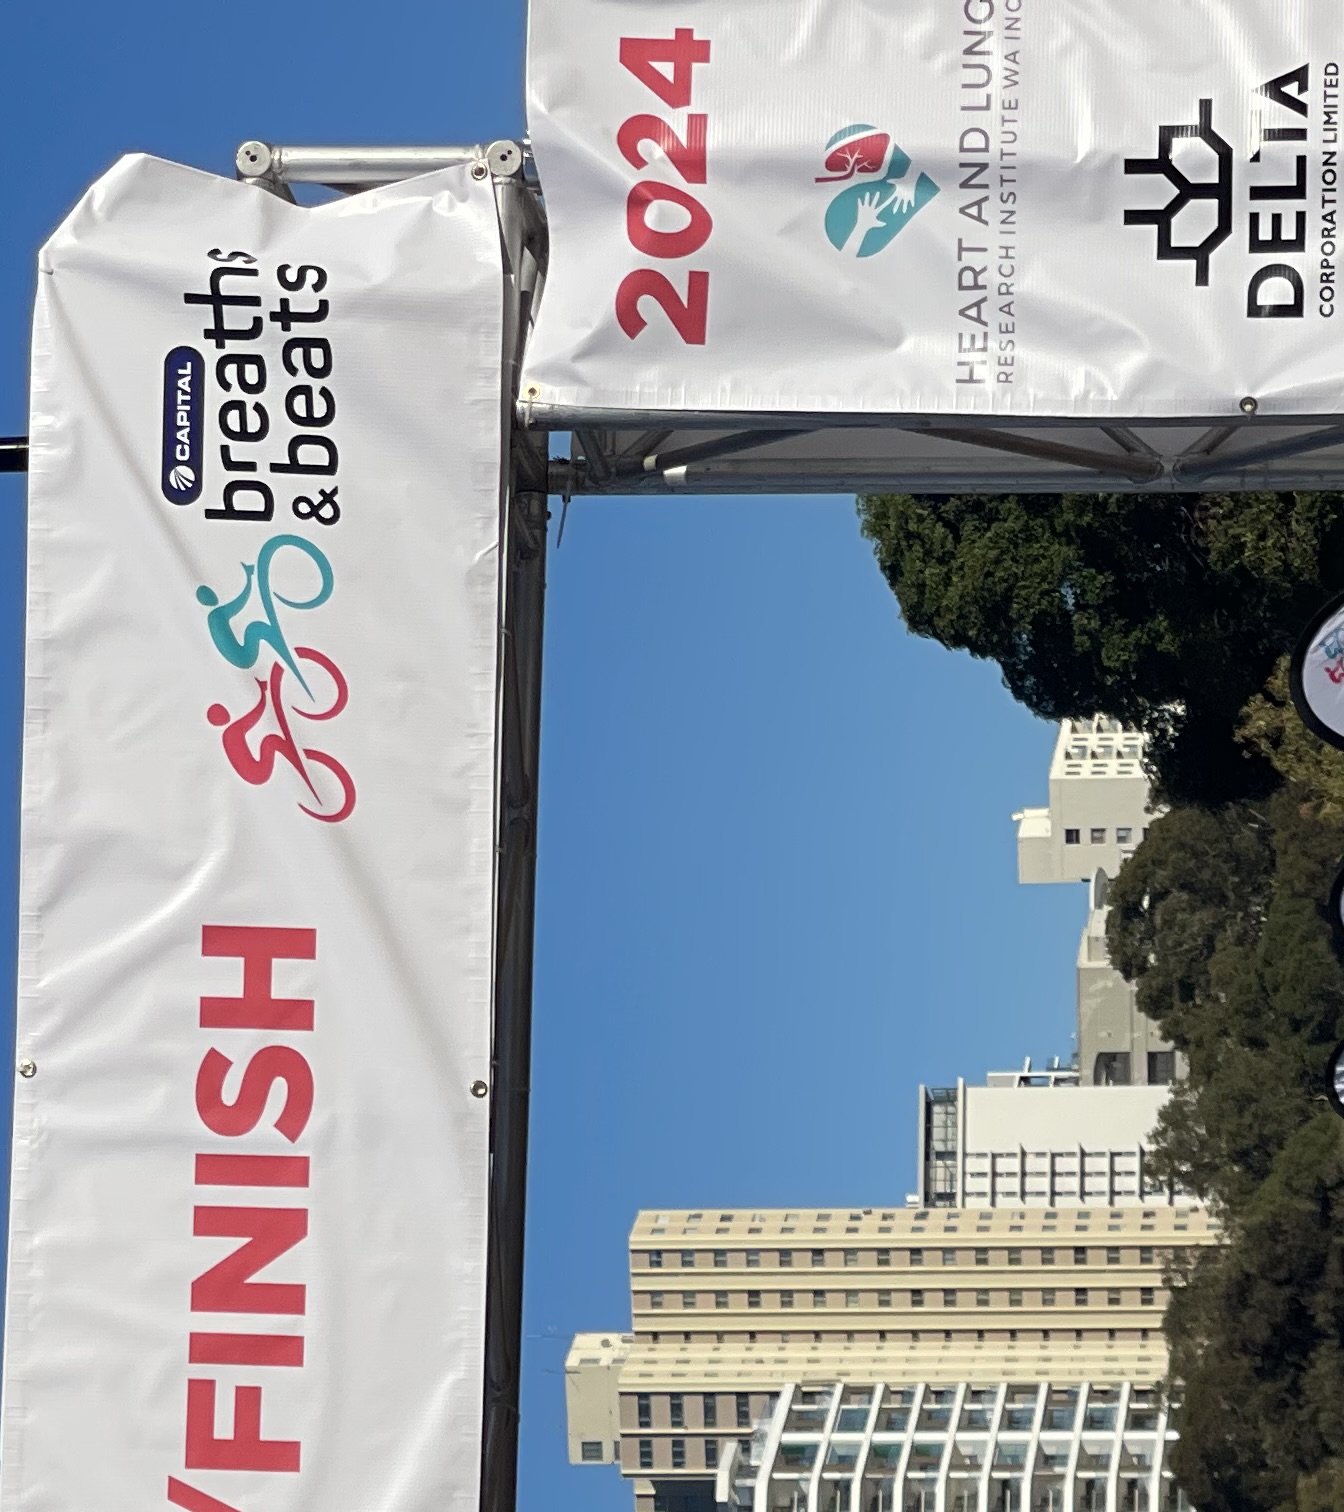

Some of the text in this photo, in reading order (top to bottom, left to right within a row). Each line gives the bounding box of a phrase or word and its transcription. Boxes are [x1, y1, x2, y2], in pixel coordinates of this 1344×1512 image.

[615, 28, 713, 345] 2024
[957, 0, 995, 384] HEART AND LUNG
[997, 0, 1022, 384] RESEARCH INSTITUTE WA INC
[1247, 62, 1310, 318] DELTA
[1319, 62, 1340, 318] CORPORATION LIMITED
[175, 361, 193, 461] CAPITAL
[184, 248, 274, 521] breaths
